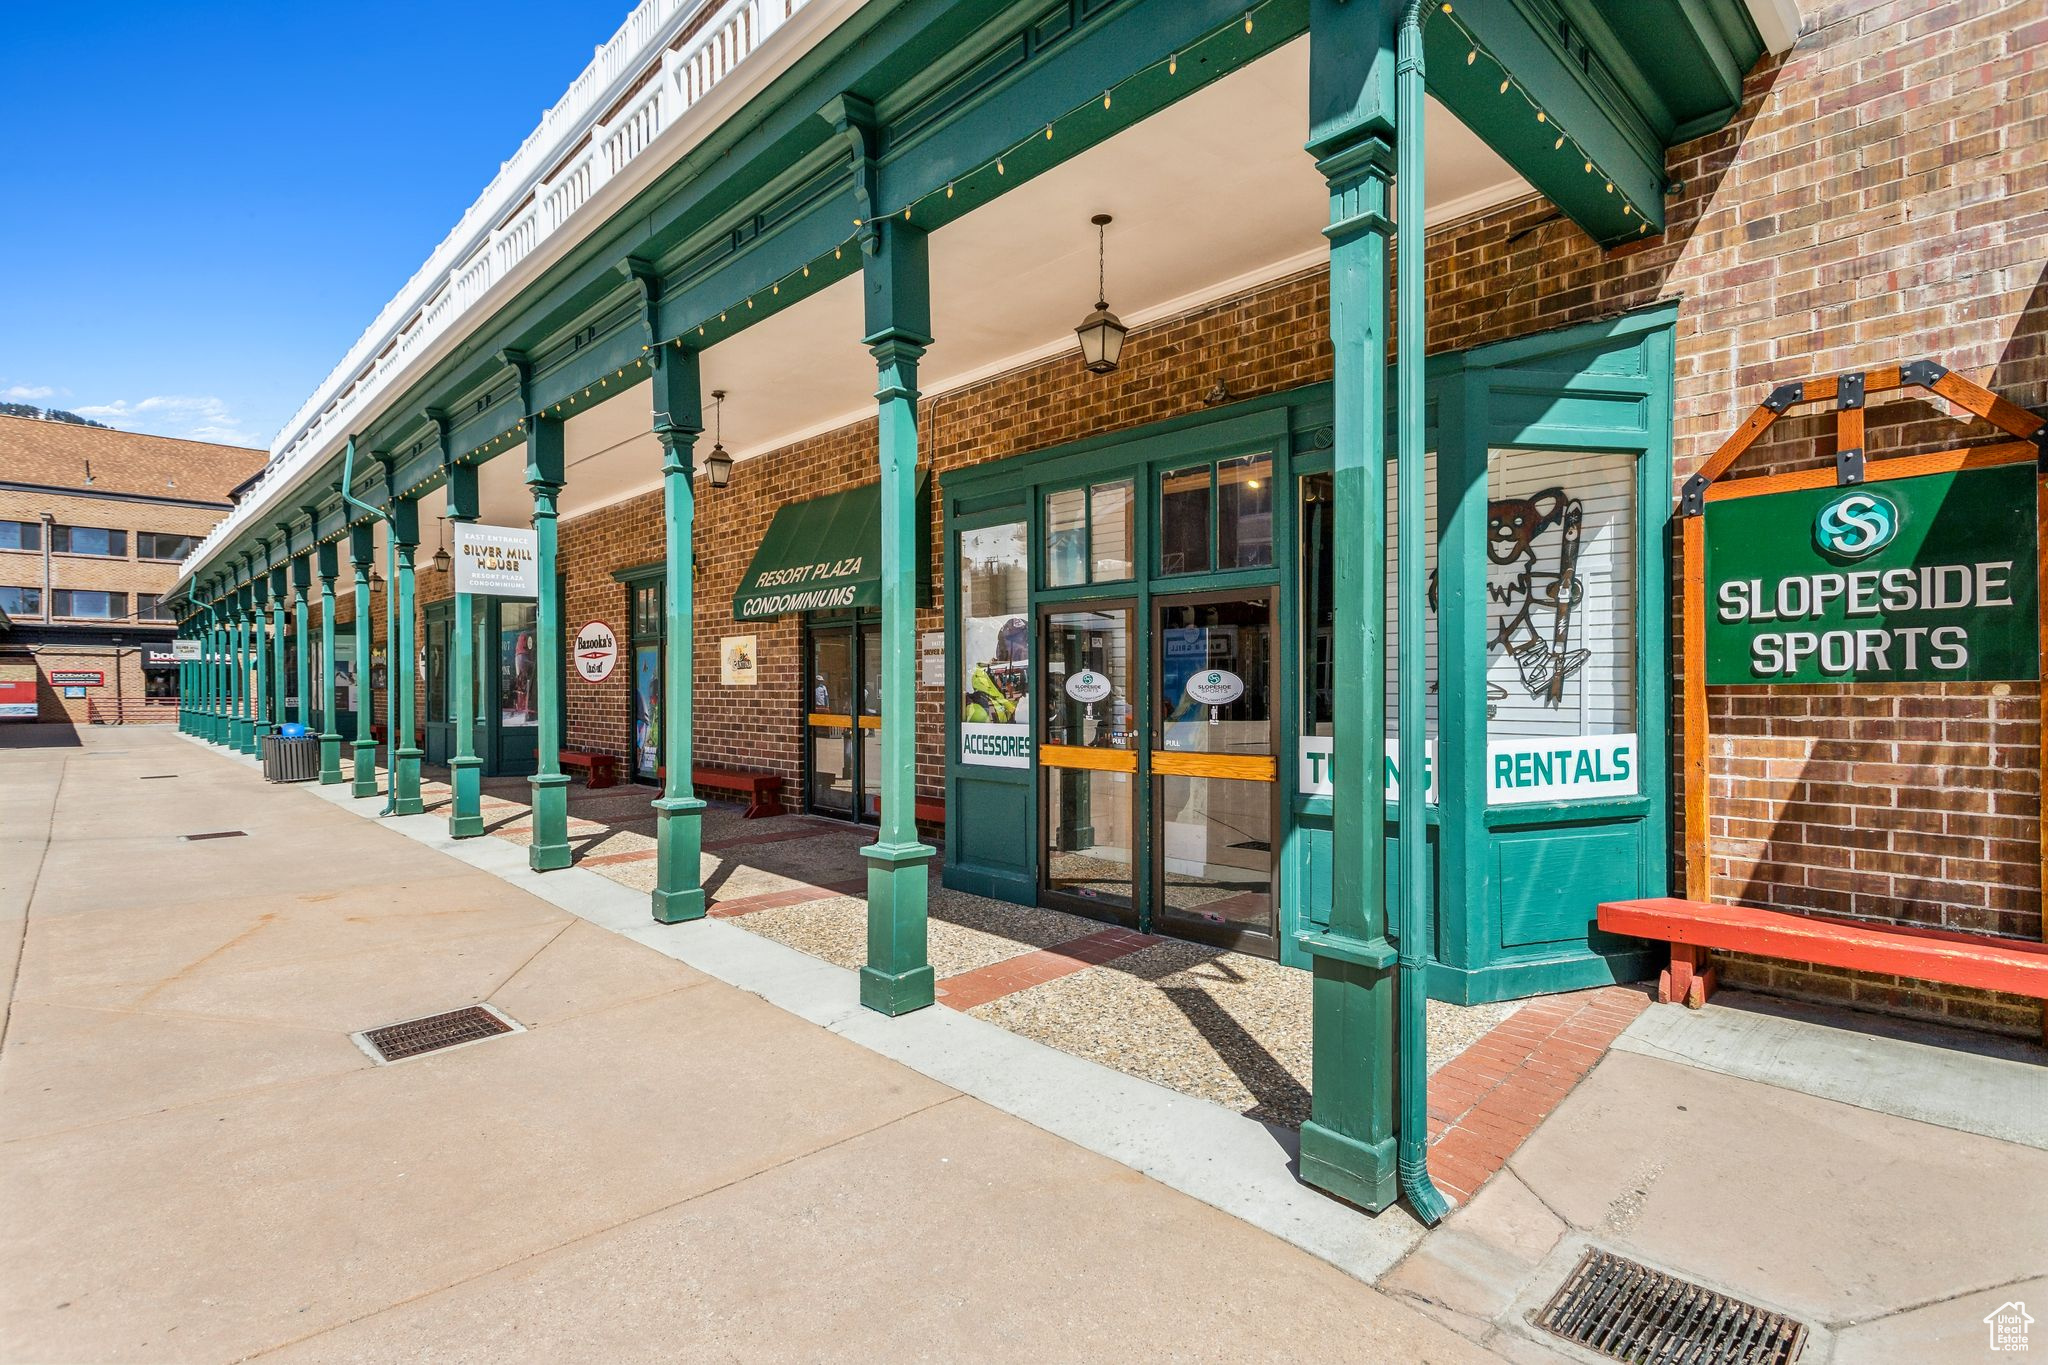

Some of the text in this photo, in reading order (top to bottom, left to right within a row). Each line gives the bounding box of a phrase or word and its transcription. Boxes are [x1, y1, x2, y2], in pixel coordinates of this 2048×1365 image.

[465, 533, 529, 545] EAST ENTRANCE
[463, 544, 532, 560] SILVER MILL
[469, 580, 526, 589] CONDOMINIUMS
[471, 572, 500, 580] RESORT
[755, 557, 863, 588] RESORT PLAZA
[743, 585, 857, 617] CONDOMINIUMS
[1718, 560, 2014, 620] SLOPESIDE
[577, 634, 613, 650] Bazooka's
[1752, 626, 1969, 674] SPORTS
[963, 733, 1030, 758] ACCESSORIES
[1494, 747, 1630, 789] RENTALS
